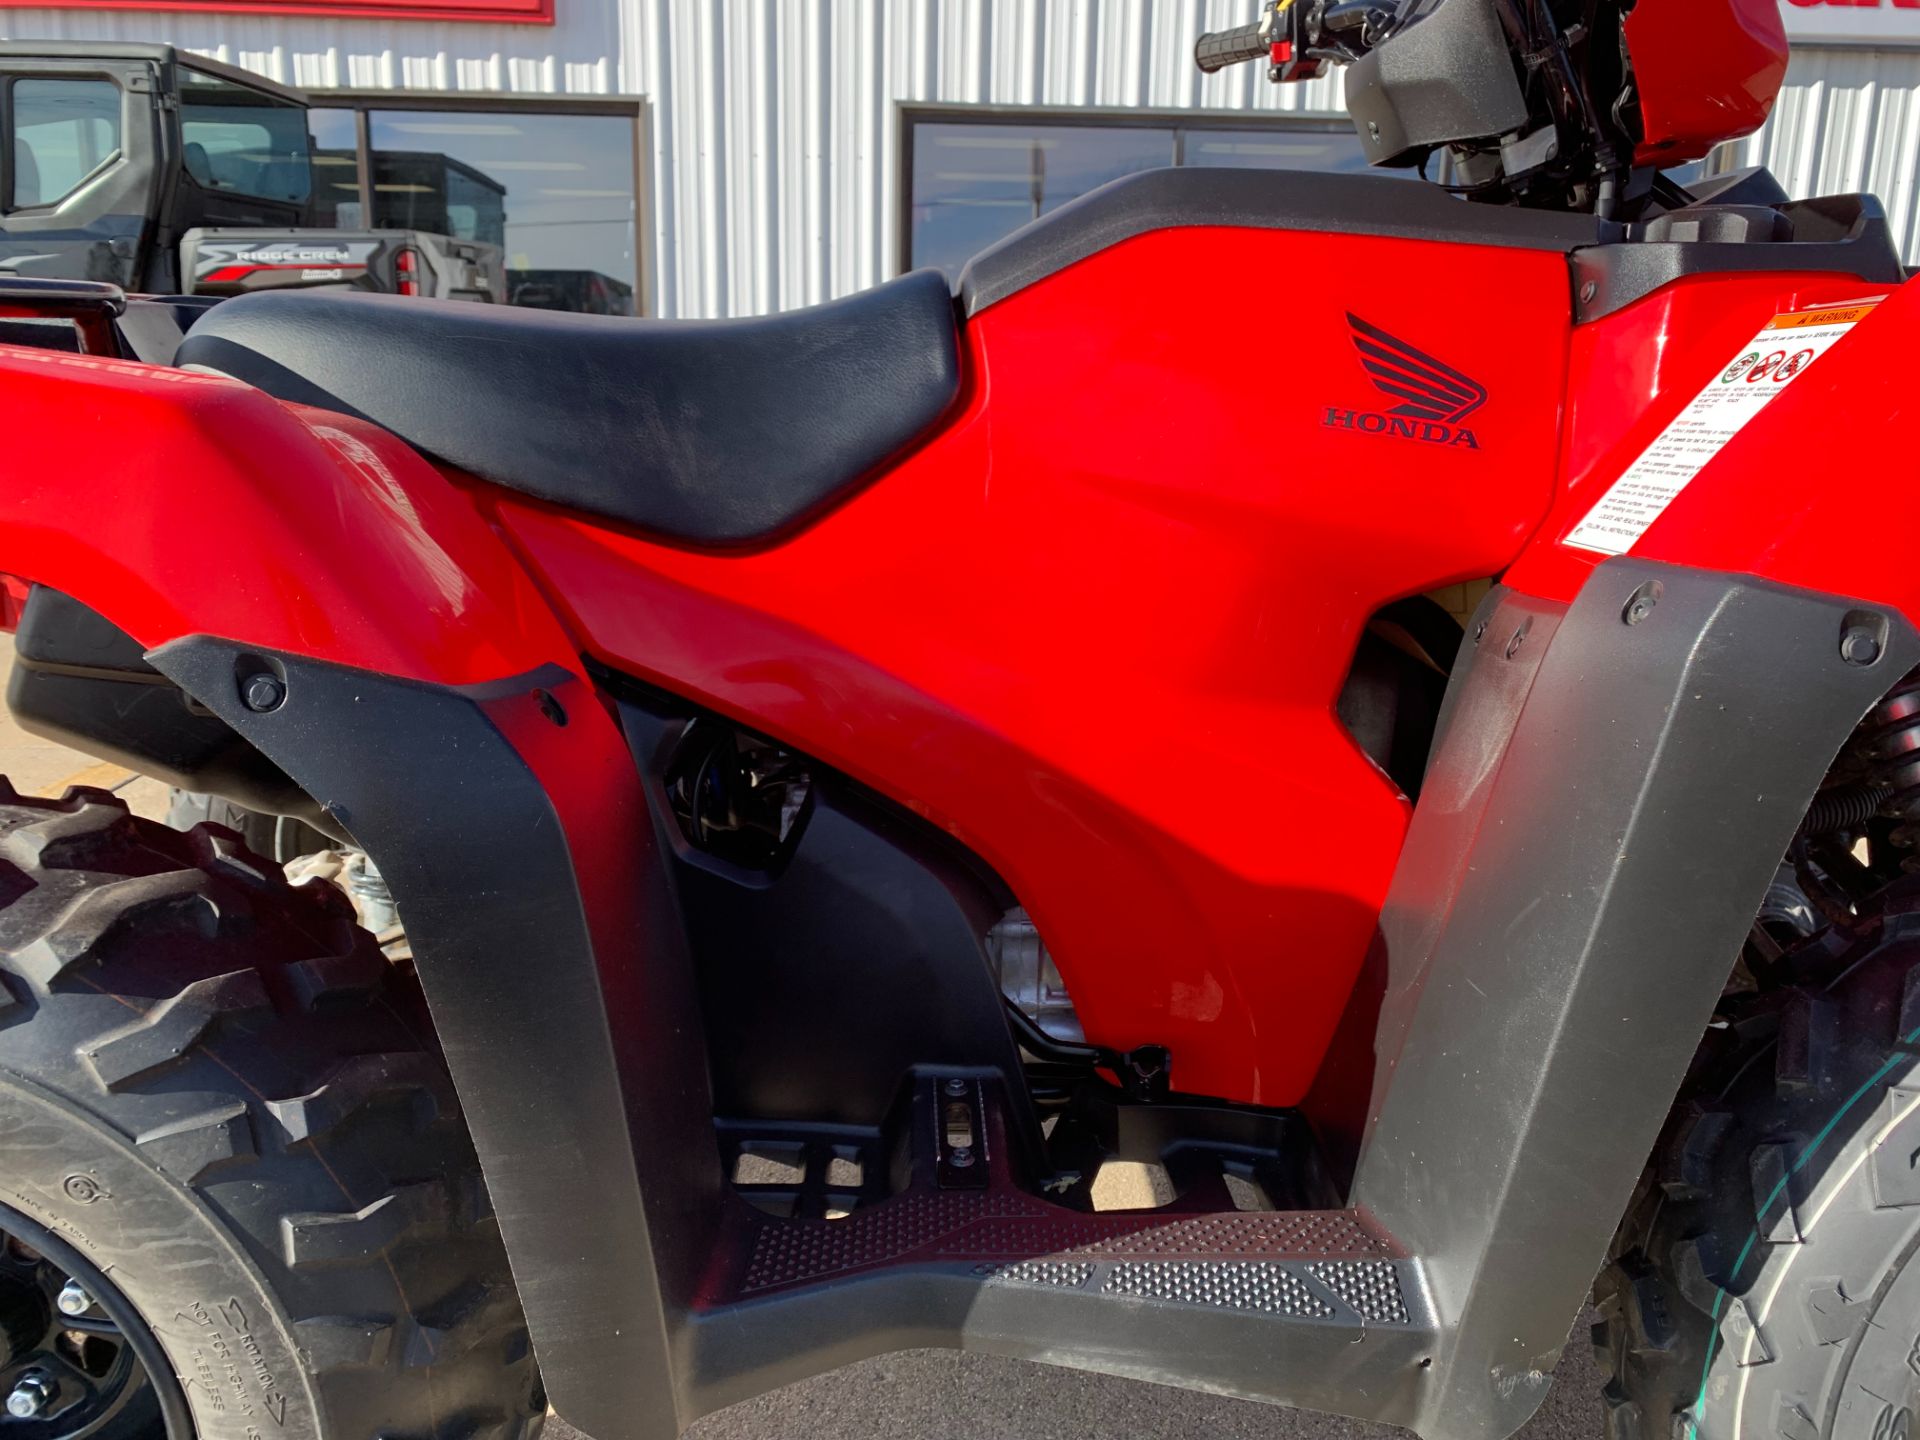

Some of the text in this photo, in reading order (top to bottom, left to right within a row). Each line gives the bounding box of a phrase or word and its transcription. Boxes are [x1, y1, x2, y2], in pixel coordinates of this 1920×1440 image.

[1809, 309, 1859, 323] WARNING
[1323, 407, 1480, 450] HONDA
[187, 1301, 214, 1327] NOT
[208, 1331, 230, 1360] FOR
[240, 1333, 275, 1391] ROTATION
